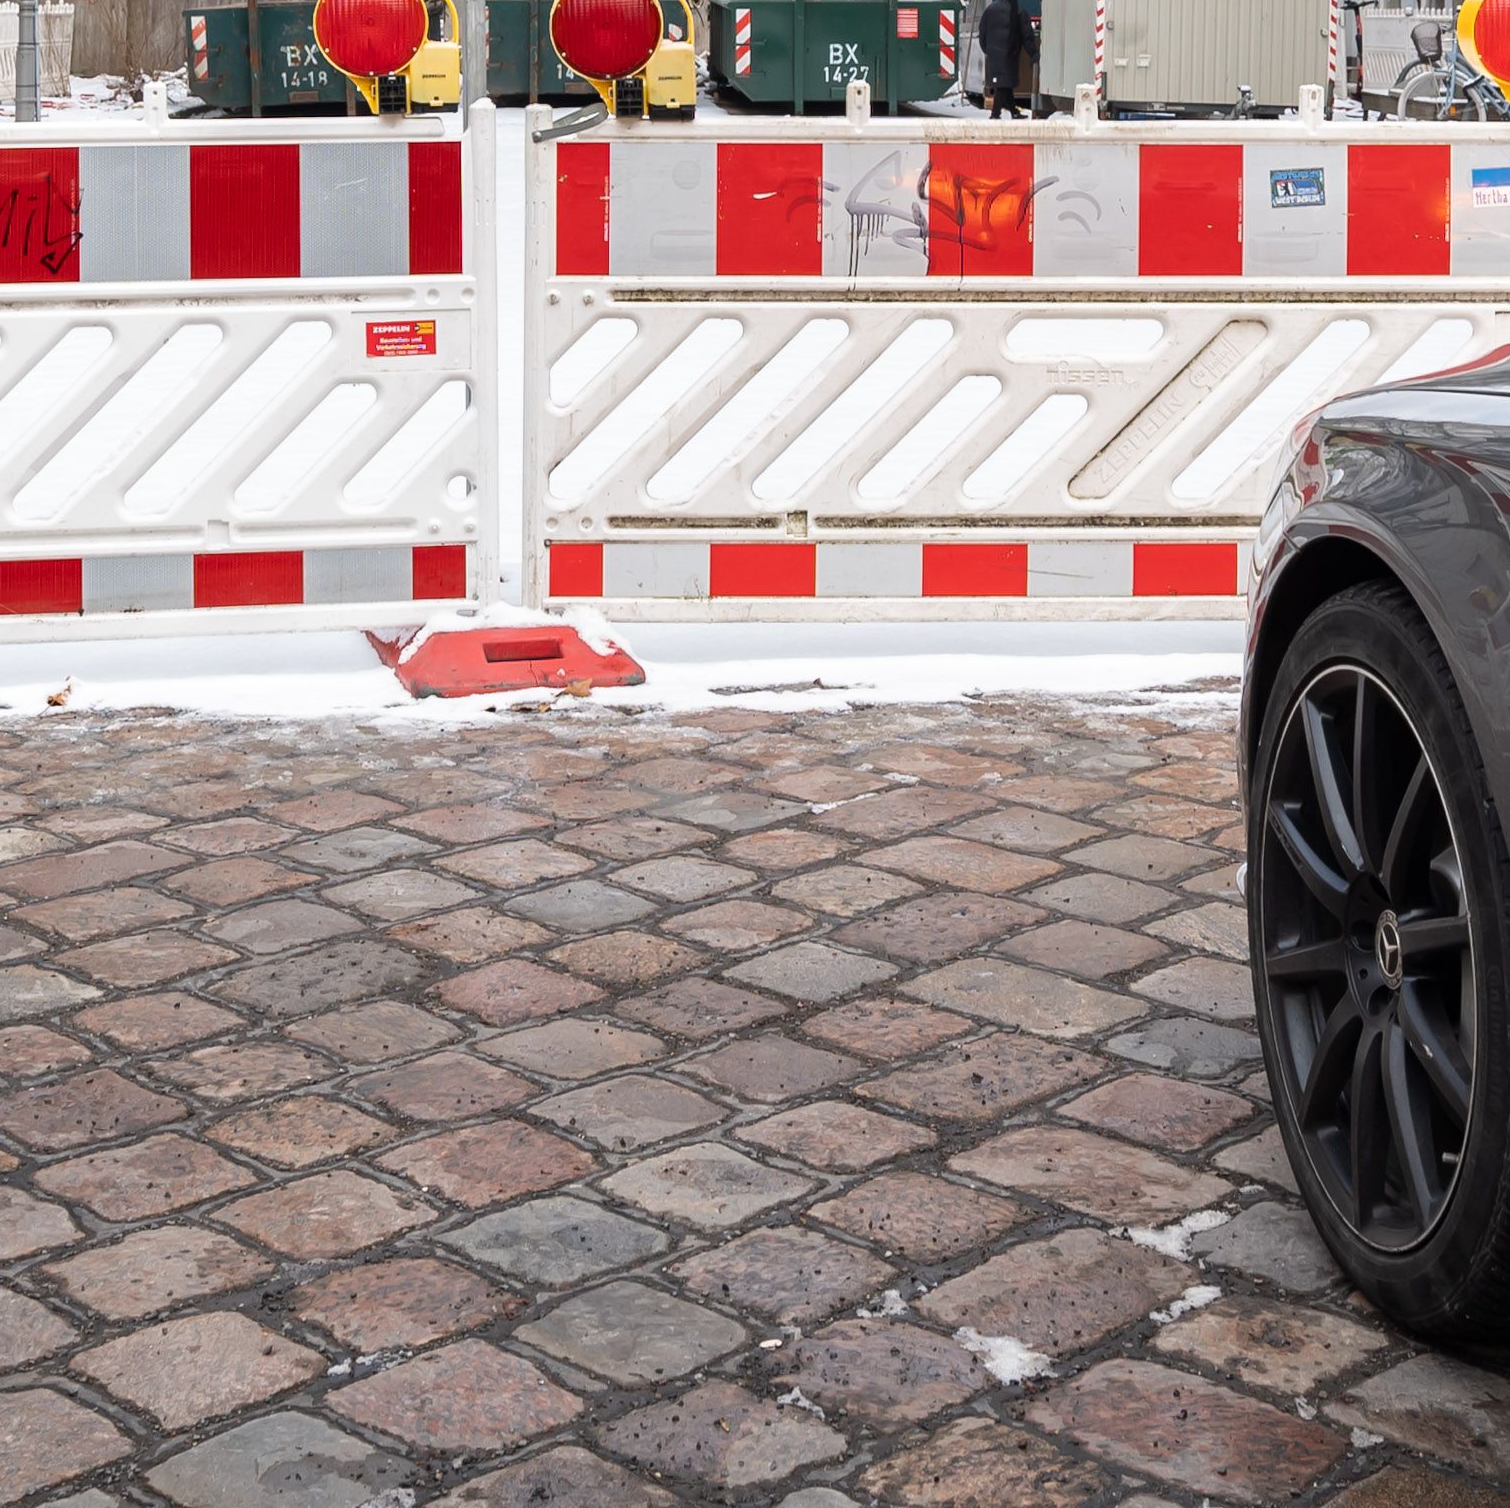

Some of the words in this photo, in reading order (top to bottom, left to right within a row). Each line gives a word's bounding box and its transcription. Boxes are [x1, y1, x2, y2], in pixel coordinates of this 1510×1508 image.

[285, 43, 320, 67] BX
[829, 43, 859, 65] BX
[281, 70, 328, 88] 14-18
[823, 65, 869, 84] 14-27
[1475, 189, 1508, 206] Hertha
[372, 324, 411, 334] ZEPPELIN
[1046, 360, 1125, 385] nissen
